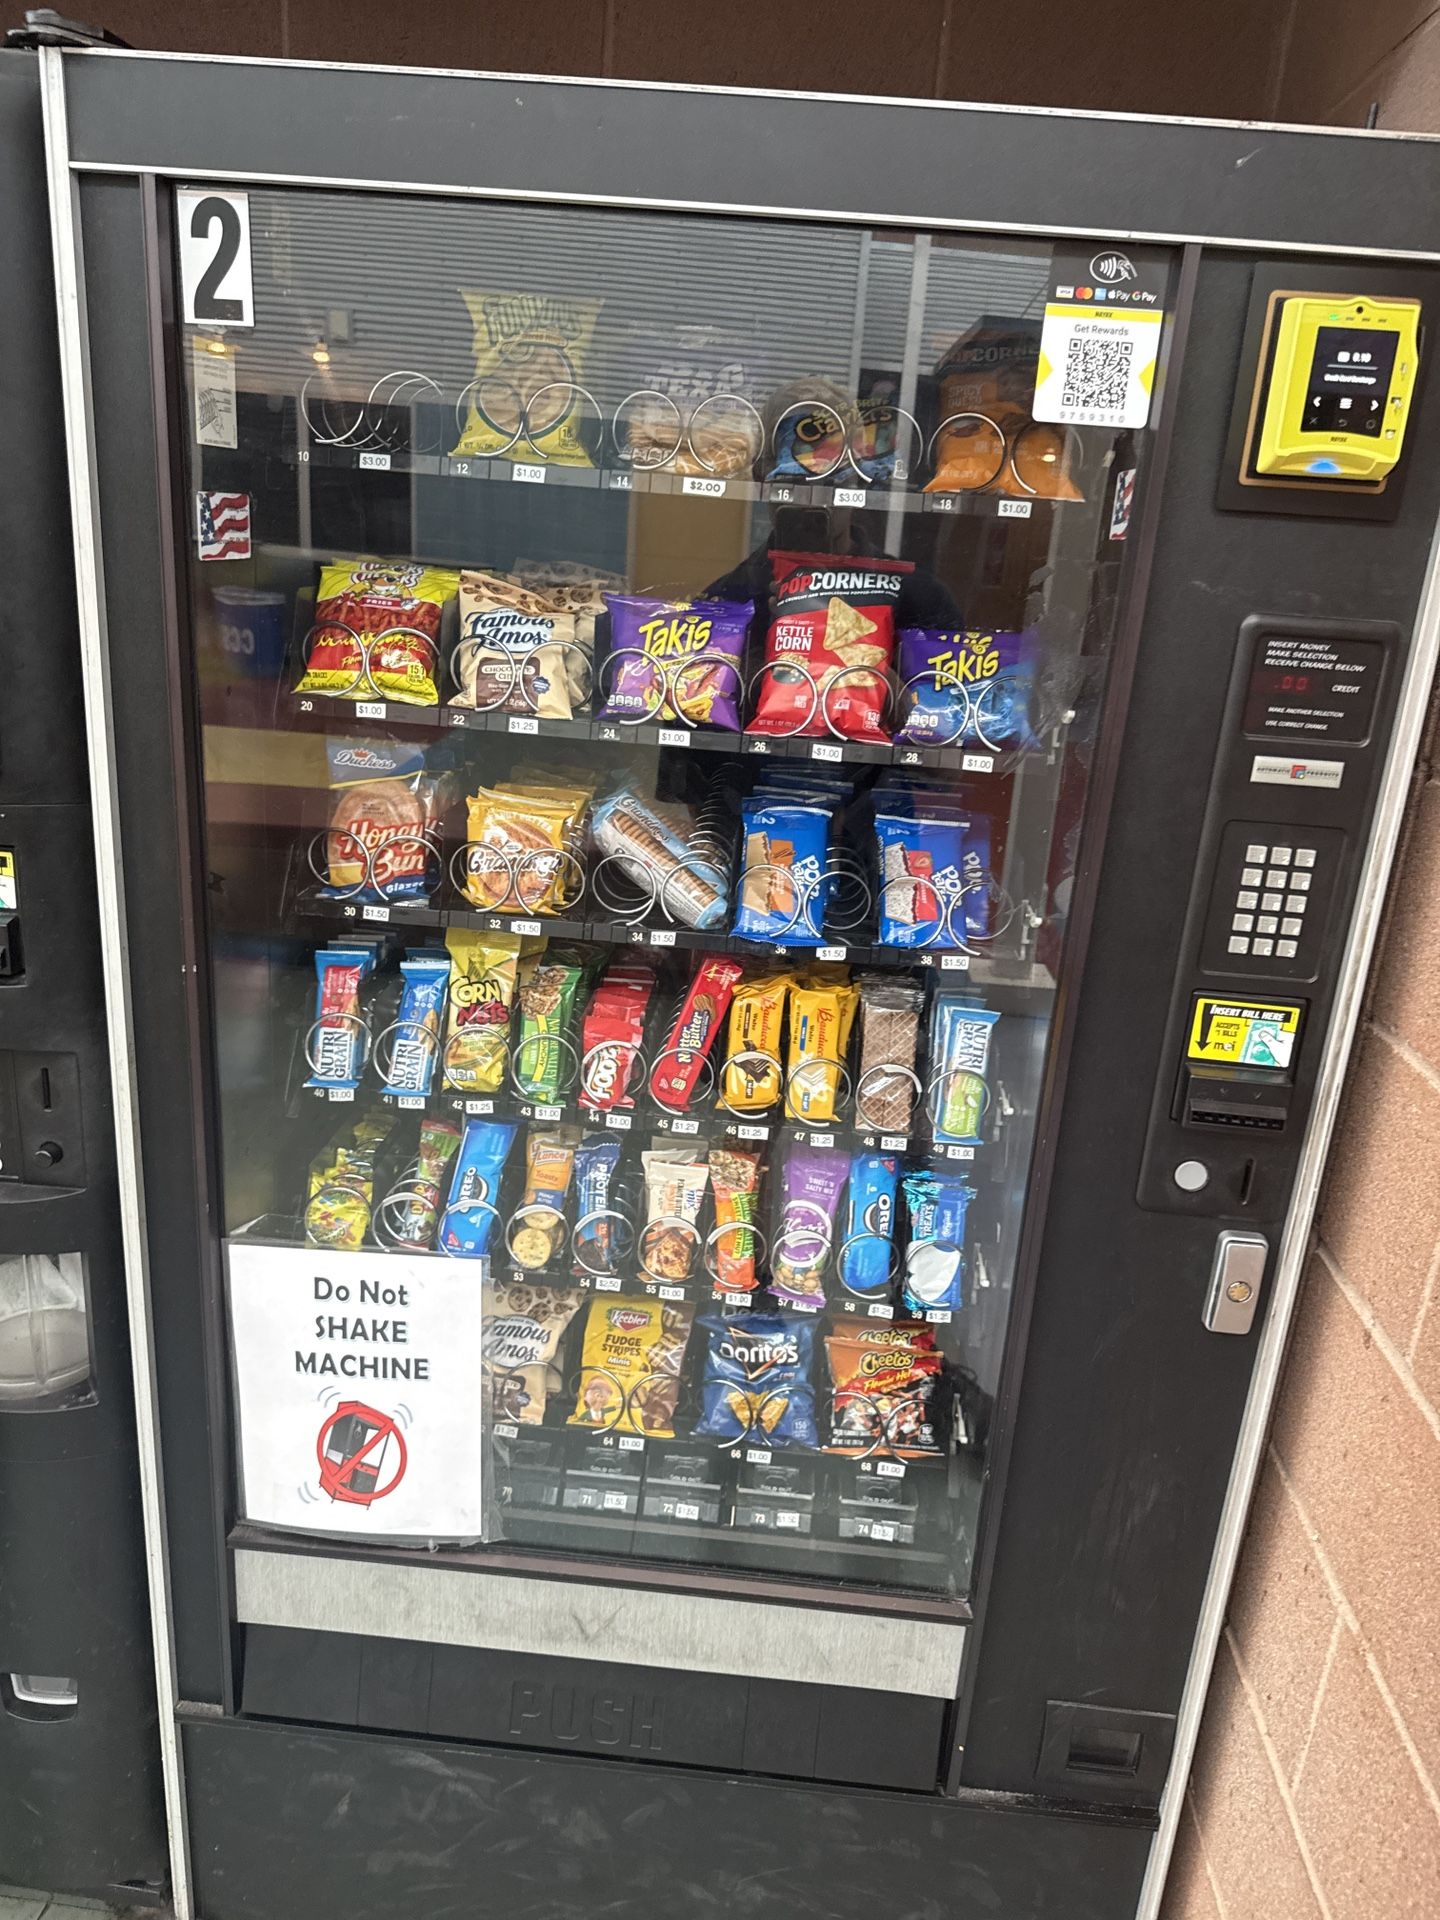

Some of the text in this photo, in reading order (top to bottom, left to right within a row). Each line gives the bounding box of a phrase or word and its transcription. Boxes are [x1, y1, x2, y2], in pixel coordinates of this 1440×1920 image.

[191, 196, 243, 321] 2
[1142, 292, 1157, 303] Pay
[1074, 324, 1129, 336] Get Rewards
[297, 450, 310, 462] 10
[361, 456, 387, 468] $3.00
[456, 463, 468, 474] 12
[516, 467, 541, 480] $1.00
[617, 476, 628, 487] 14
[689, 480, 721, 493] $2.00
[778, 489, 789, 500] 16
[839, 493, 864, 503] $3.00
[940, 499, 952, 509] 18
[1002, 504, 1028, 515] $1.00
[778, 571, 901, 600] POPCORNERS
[466, 612, 555, 637] Famous
[776, 625, 814, 638] KETTLE
[473, 628, 548, 650] Amos
[638, 616, 713, 667] Takis
[775, 637, 813, 651] CORN
[1267, 640, 1331, 651] INSERT MONEY
[1266, 649, 1339, 660] MAKE SELECTION
[927, 644, 1000, 692] Takis
[1264, 658, 1366, 672] RECEIVE CHANGE BELOW
[1332, 684, 1361, 693] CREDIT
[301, 701, 313, 711] 20
[358, 705, 382, 715] $1.00
[1268, 706, 1344, 718] MAKE ANOTHER SELECTION
[453, 715, 465, 725] 22
[511, 721, 534, 731] $1.25
[603, 728, 615, 738] 24
[661, 732, 685, 743] $1.00
[754, 742, 766, 752] 26
[334, 750, 396, 769] Duchess
[906, 752, 918, 762] 28
[967, 759, 991, 770] $1.00
[341, 820, 424, 853] Honey
[370, 849, 424, 882] Bun
[344, 907, 356, 916] 30
[364, 908, 387, 918] $1.50
[490, 919, 501, 929] 32
[517, 923, 539, 933] $1.50
[631, 932, 643, 941] 34
[652, 933, 674, 942] $1.50
[775, 945, 786, 954] 36
[822, 947, 844, 957] $1.50
[921, 956, 932, 965] 38
[943, 957, 967, 967] $1.50
[450, 976, 502, 1008] CORN
[457, 1002, 509, 1026] NUTS
[1210, 1004, 1242, 1016] INSERT
[1241, 1009, 1260, 1019] BILL
[1261, 1011, 1286, 1021] HERE
[690, 1011, 703, 1049] Butter
[1215, 1022, 1240, 1030] ACCEPTS
[958, 1022, 974, 1069] GRAIN
[973, 1023, 988, 1070] NUTRI
[320, 1030, 335, 1077] NUTRI
[335, 1031, 348, 1078] GRAIN
[390, 1043, 407, 1088] NUTRI
[405, 1044, 422, 1090] GRAIN
[314, 1088, 325, 1097] 40
[330, 1089, 351, 1099] $1.00
[383, 1095, 393, 1104] 41
[400, 1097, 421, 1106] $1.00
[452, 1100, 463, 1109] 42
[469, 1103, 490, 1111] $1.25
[521, 1107, 531, 1116] 43
[538, 1109, 560, 1117] $1.00
[589, 1112, 600, 1122] 44
[608, 1117, 630, 1126] $1.00
[657, 1119, 669, 1129] 45
[675, 1122, 695, 1131] $1.25
[726, 1126, 737, 1135] 46
[741, 1129, 762, 1137] $1.25
[794, 1132, 805, 1141] 47
[810, 1136, 832, 1144] $1.25
[863, 1137, 875, 1146] 48
[883, 1140, 905, 1148] $1.25
[933, 1144, 944, 1153] 49
[537, 1151, 566, 1161] Lance
[952, 1149, 972, 1157] $1.00
[535, 1170, 558, 1181] Toasty
[808, 1177, 828, 1187] SWEET
[805, 1184, 823, 1192] SALTY
[924, 1204, 935, 1237] TREATS
[513, 1272, 524, 1281] 53
[579, 1278, 591, 1288] 54
[599, 1279, 618, 1288] $2.50
[313, 1276, 409, 1306] Do Not
[645, 1284, 657, 1294] 55
[661, 1289, 681, 1297] $1.00
[711, 1291, 722, 1300] 56
[728, 1294, 748, 1303] $1.00
[777, 1298, 788, 1307] 57
[844, 1302, 856, 1311] 58
[871, 1306, 891, 1315] $1.25
[911, 1310, 923, 1319] 59
[611, 1310, 648, 1326] Keebler
[929, 1312, 949, 1321] $1.25
[315, 1315, 408, 1343] SHAKE
[605, 1334, 643, 1347] FUDGE
[601, 1343, 642, 1357] STRIPES
[719, 1342, 799, 1364] Doritos
[294, 1350, 430, 1380] MACHINE
[607, 1356, 631, 1366] Minis
[860, 1352, 914, 1376] Cheetos
[603, 1437, 614, 1446] 64
[621, 1440, 641, 1448] $1.00
[731, 1449, 741, 1459] 66
[748, 1452, 768, 1461] $1.00
[861, 1462, 872, 1471] 68
[880, 1465, 901, 1474] $1.00
[582, 1495, 592, 1504] 71
[663, 1503, 673, 1513] 72
[754, 1513, 765, 1523] 73
[858, 1524, 869, 1534] 74
[509, 1680, 664, 1750] PUSH
